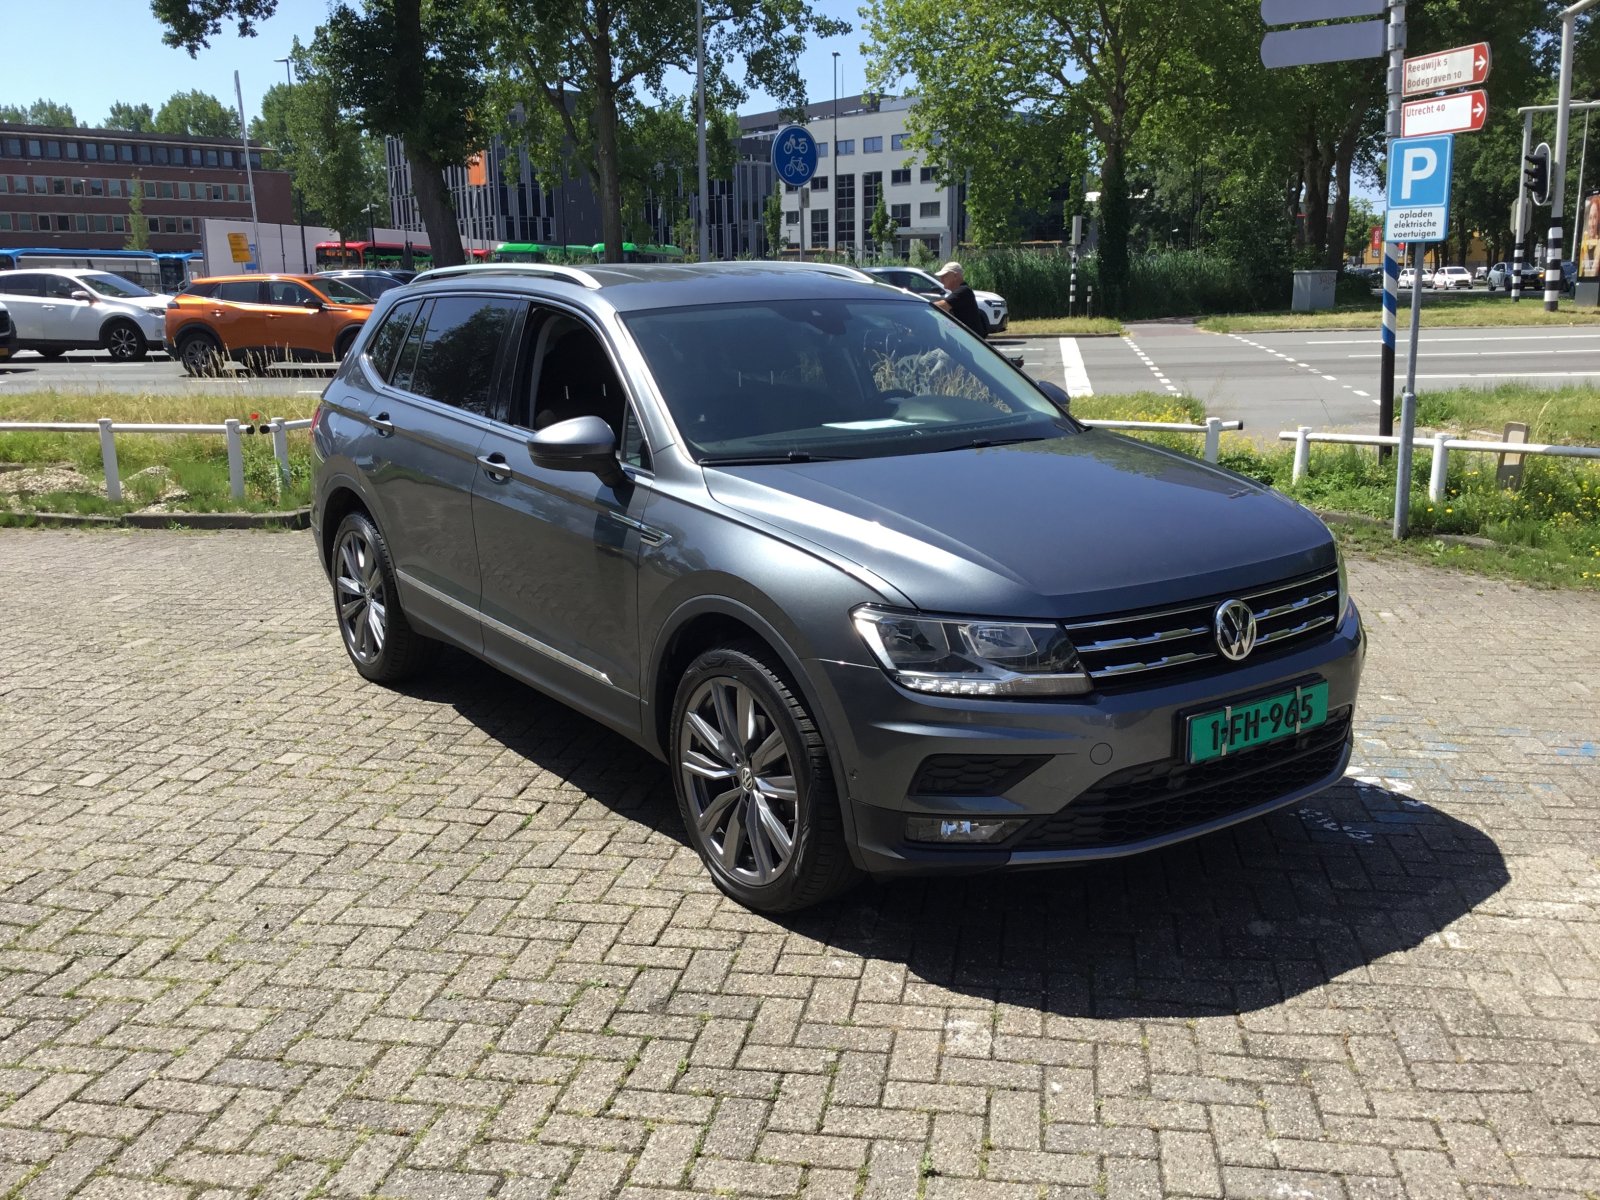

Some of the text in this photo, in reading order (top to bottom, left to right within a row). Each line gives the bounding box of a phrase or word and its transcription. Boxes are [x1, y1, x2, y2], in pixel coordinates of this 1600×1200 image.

[1407, 58, 1448, 73] Reeuwijk 5
[1407, 70, 1462, 88] Bodegraven 10
[1406, 103, 1446, 117] Utrecht 40
[1401, 147, 1438, 200] P
[1400, 210, 1433, 219] opladen
[1393, 219, 1437, 229] elektrische
[1393, 230, 1437, 239] voertuigen
